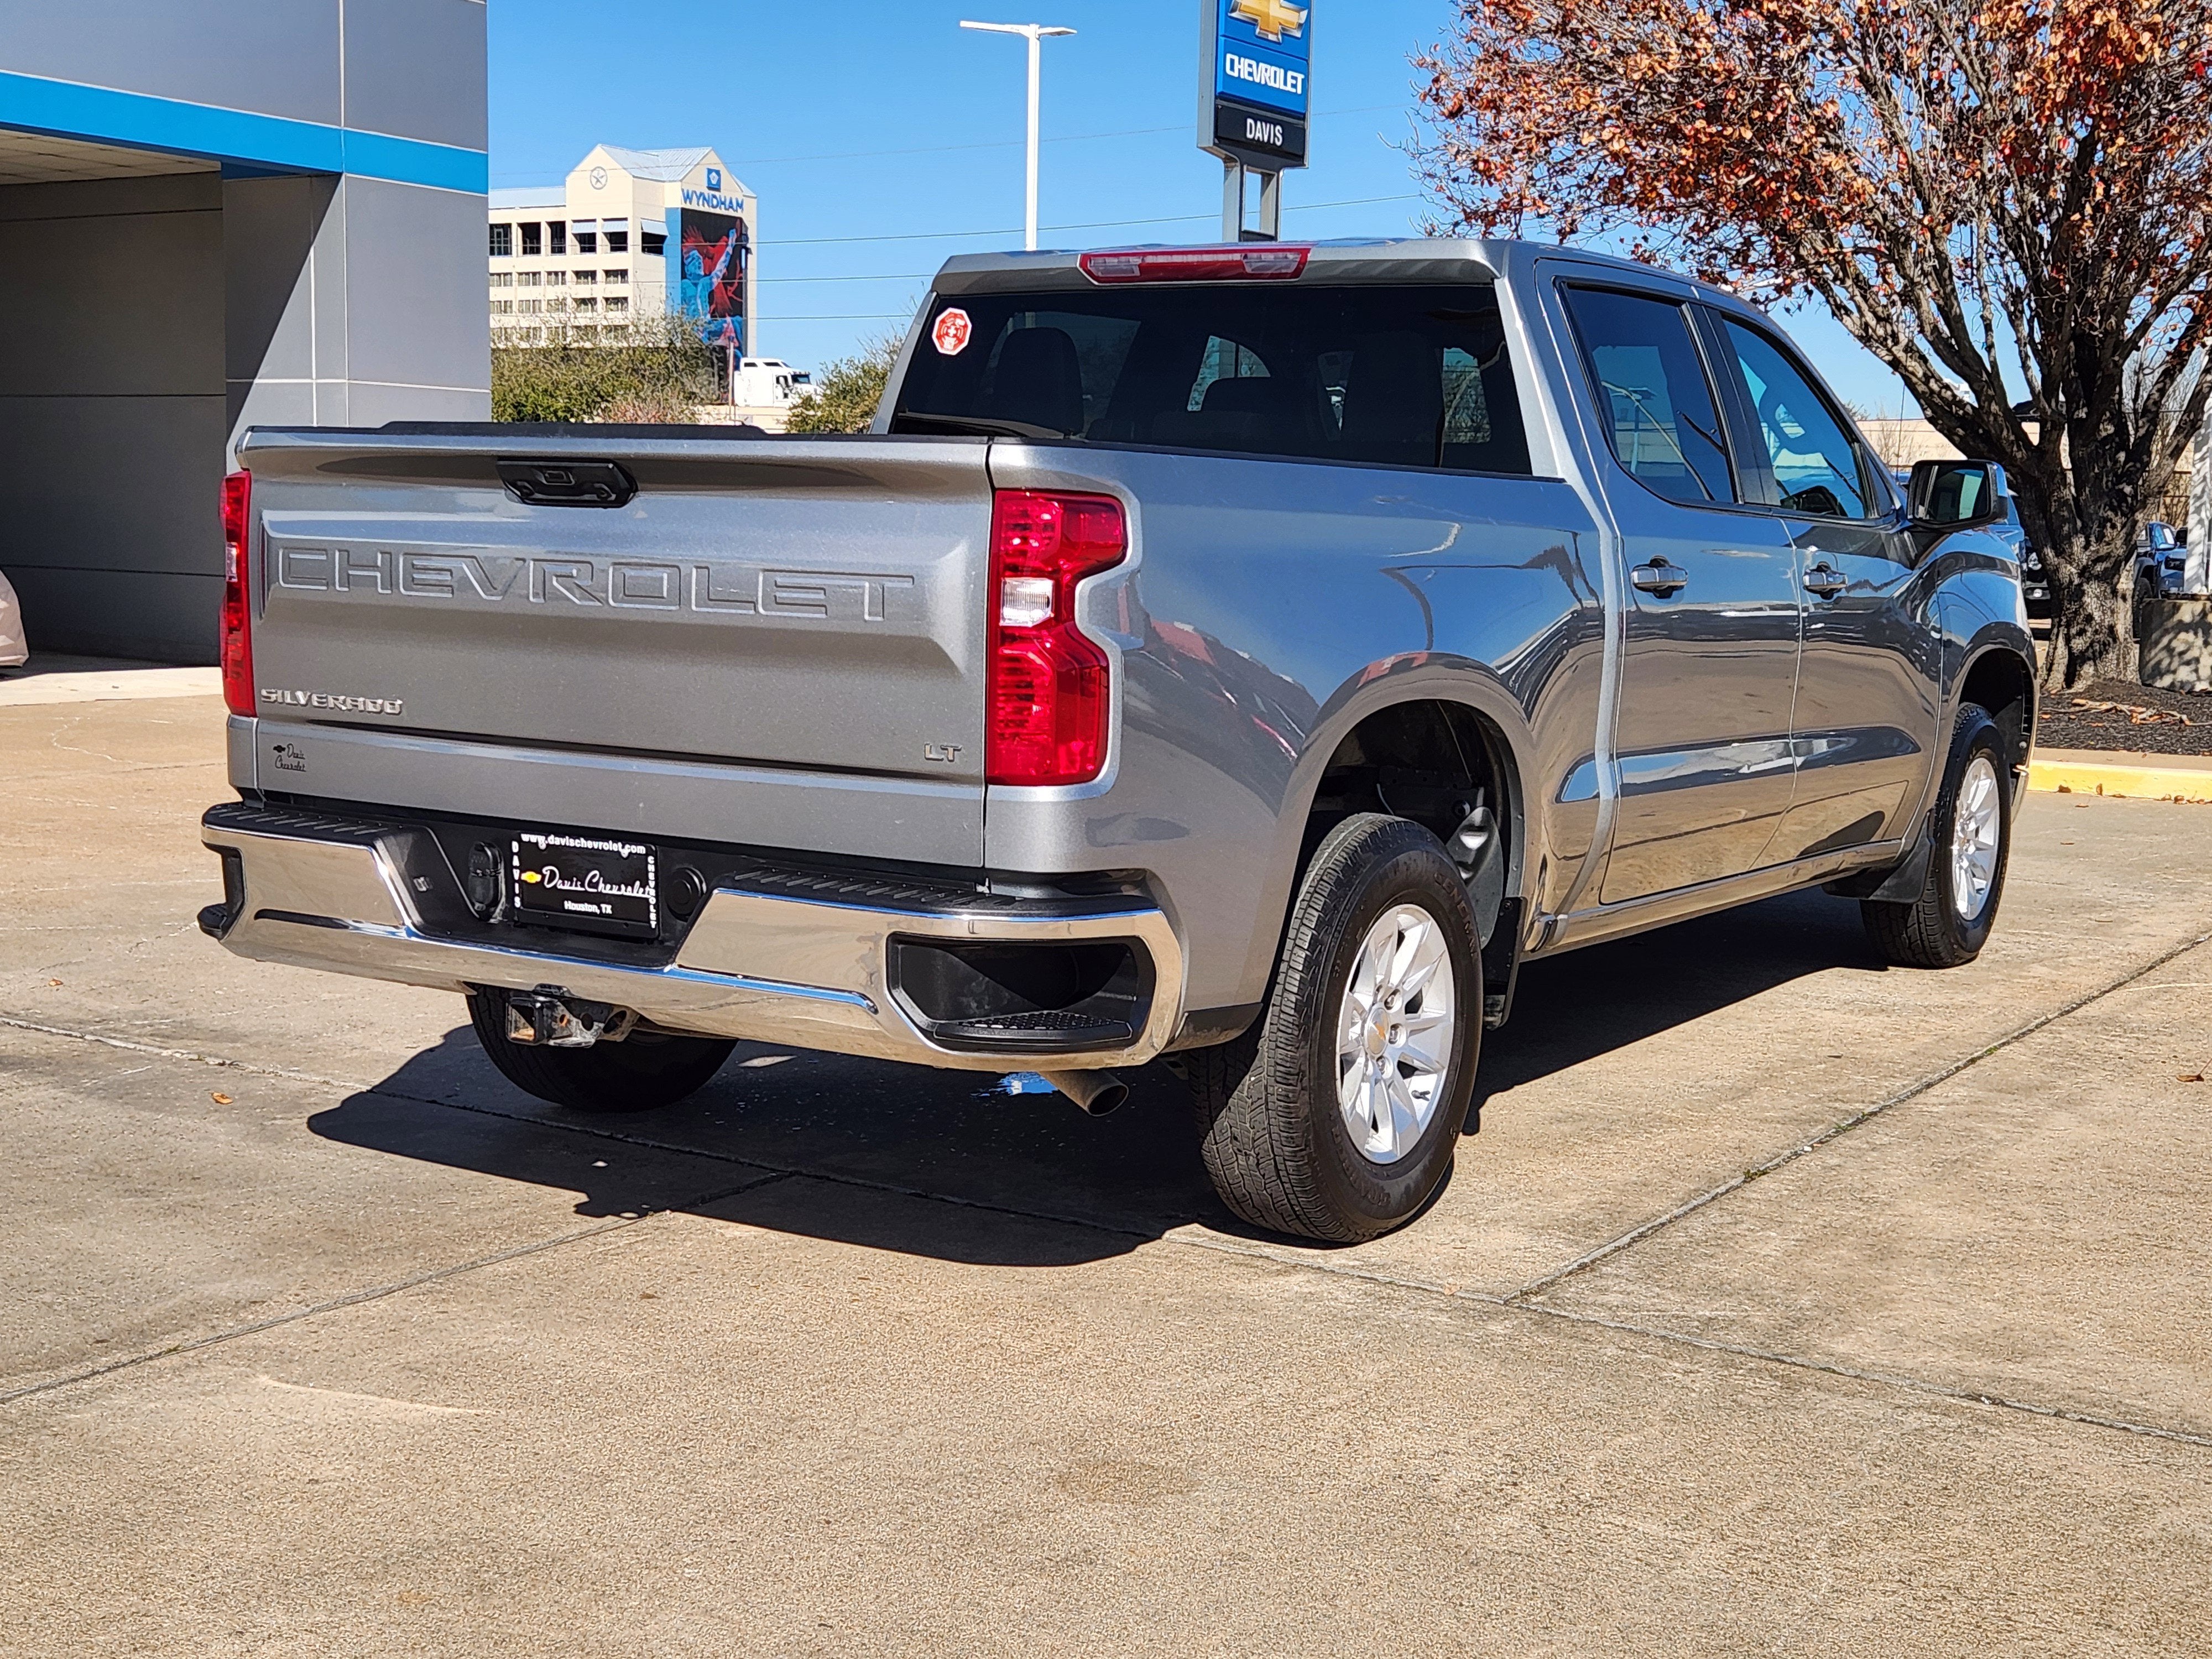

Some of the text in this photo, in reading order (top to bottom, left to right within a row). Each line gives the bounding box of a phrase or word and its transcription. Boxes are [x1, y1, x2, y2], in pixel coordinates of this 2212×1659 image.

[1225, 53, 1305, 95] CHEVROLET
[1246, 118, 1282, 146] DAVIS
[681, 188, 744, 213] WYNDHAM
[278, 547, 915, 622] CHEVROLET
[260, 688, 403, 714] SILVERADO
[924, 743, 962, 762] LT
[520, 833, 646, 854] www.davischevroletcom
[512, 841, 520, 907] DAVIS
[542, 866, 651, 898] Davis Chevrolet
[564, 900, 612, 914] Houston, TX
